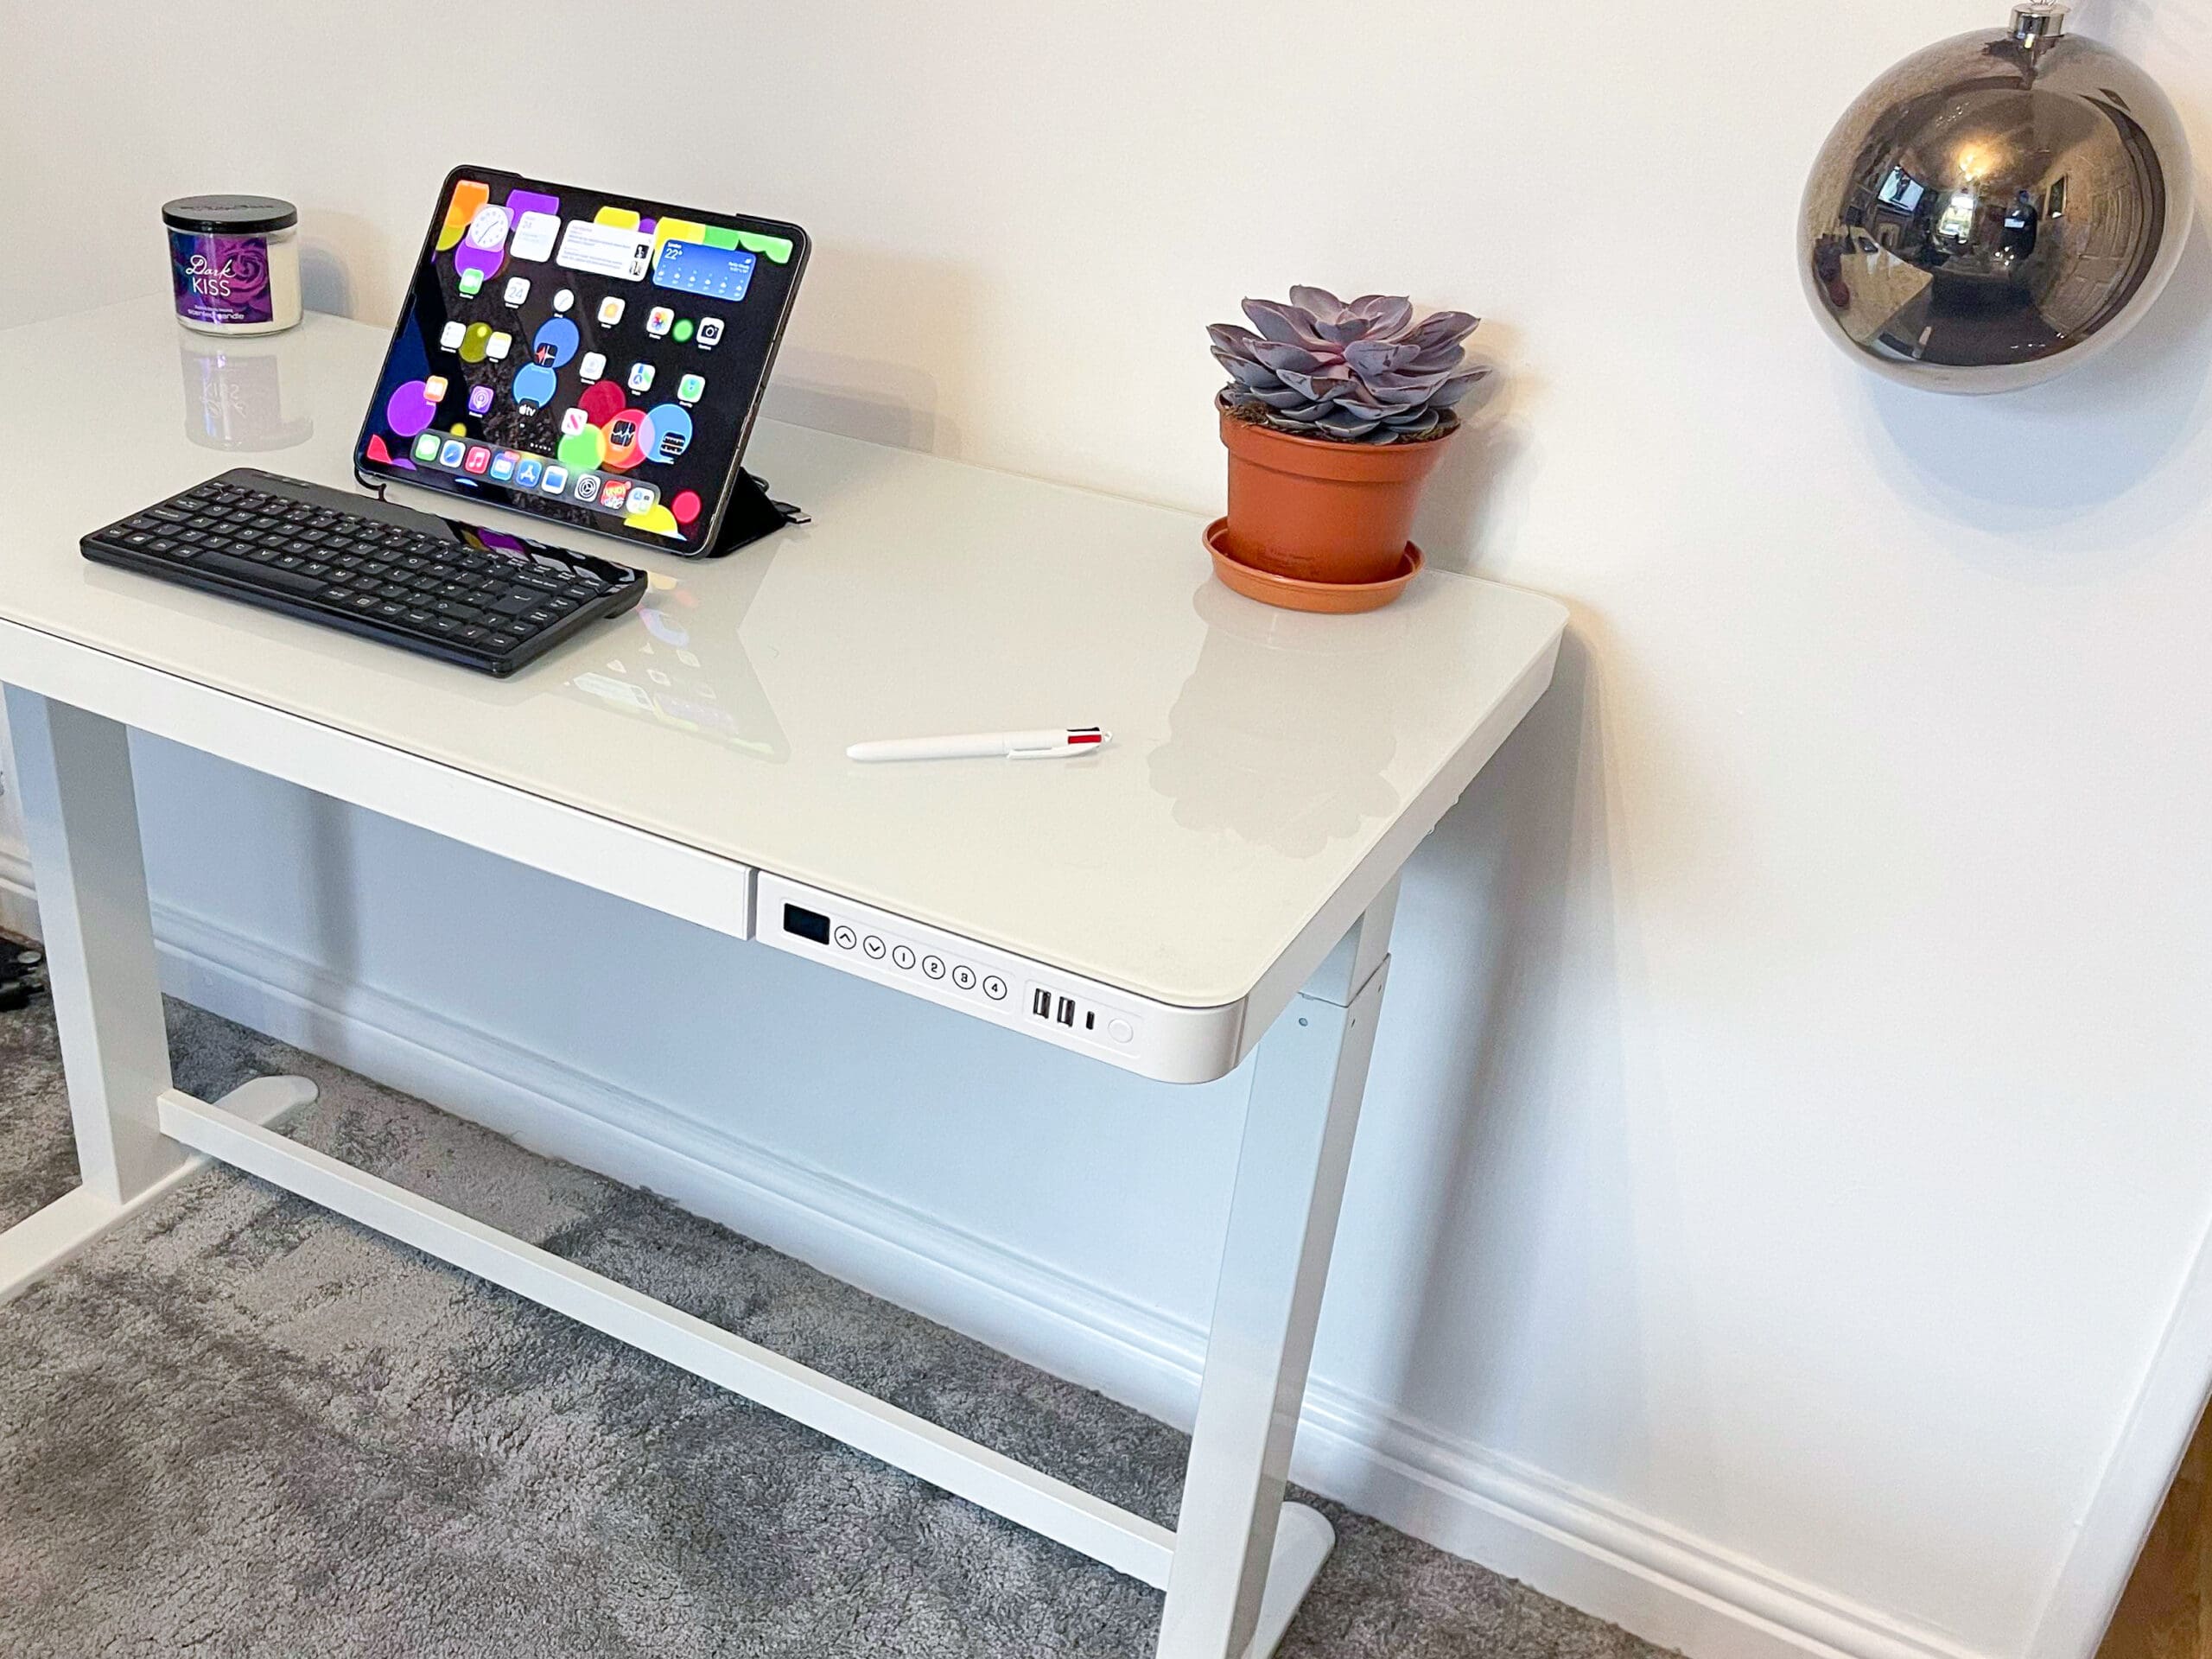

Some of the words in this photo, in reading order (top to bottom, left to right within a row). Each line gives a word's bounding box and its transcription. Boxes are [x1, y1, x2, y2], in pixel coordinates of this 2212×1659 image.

[186, 255, 237, 279] Dark
[193, 277, 231, 296] KISS
[931, 963, 938, 973] 2
[961, 972, 969, 983] 3
[991, 982, 999, 994] 4
